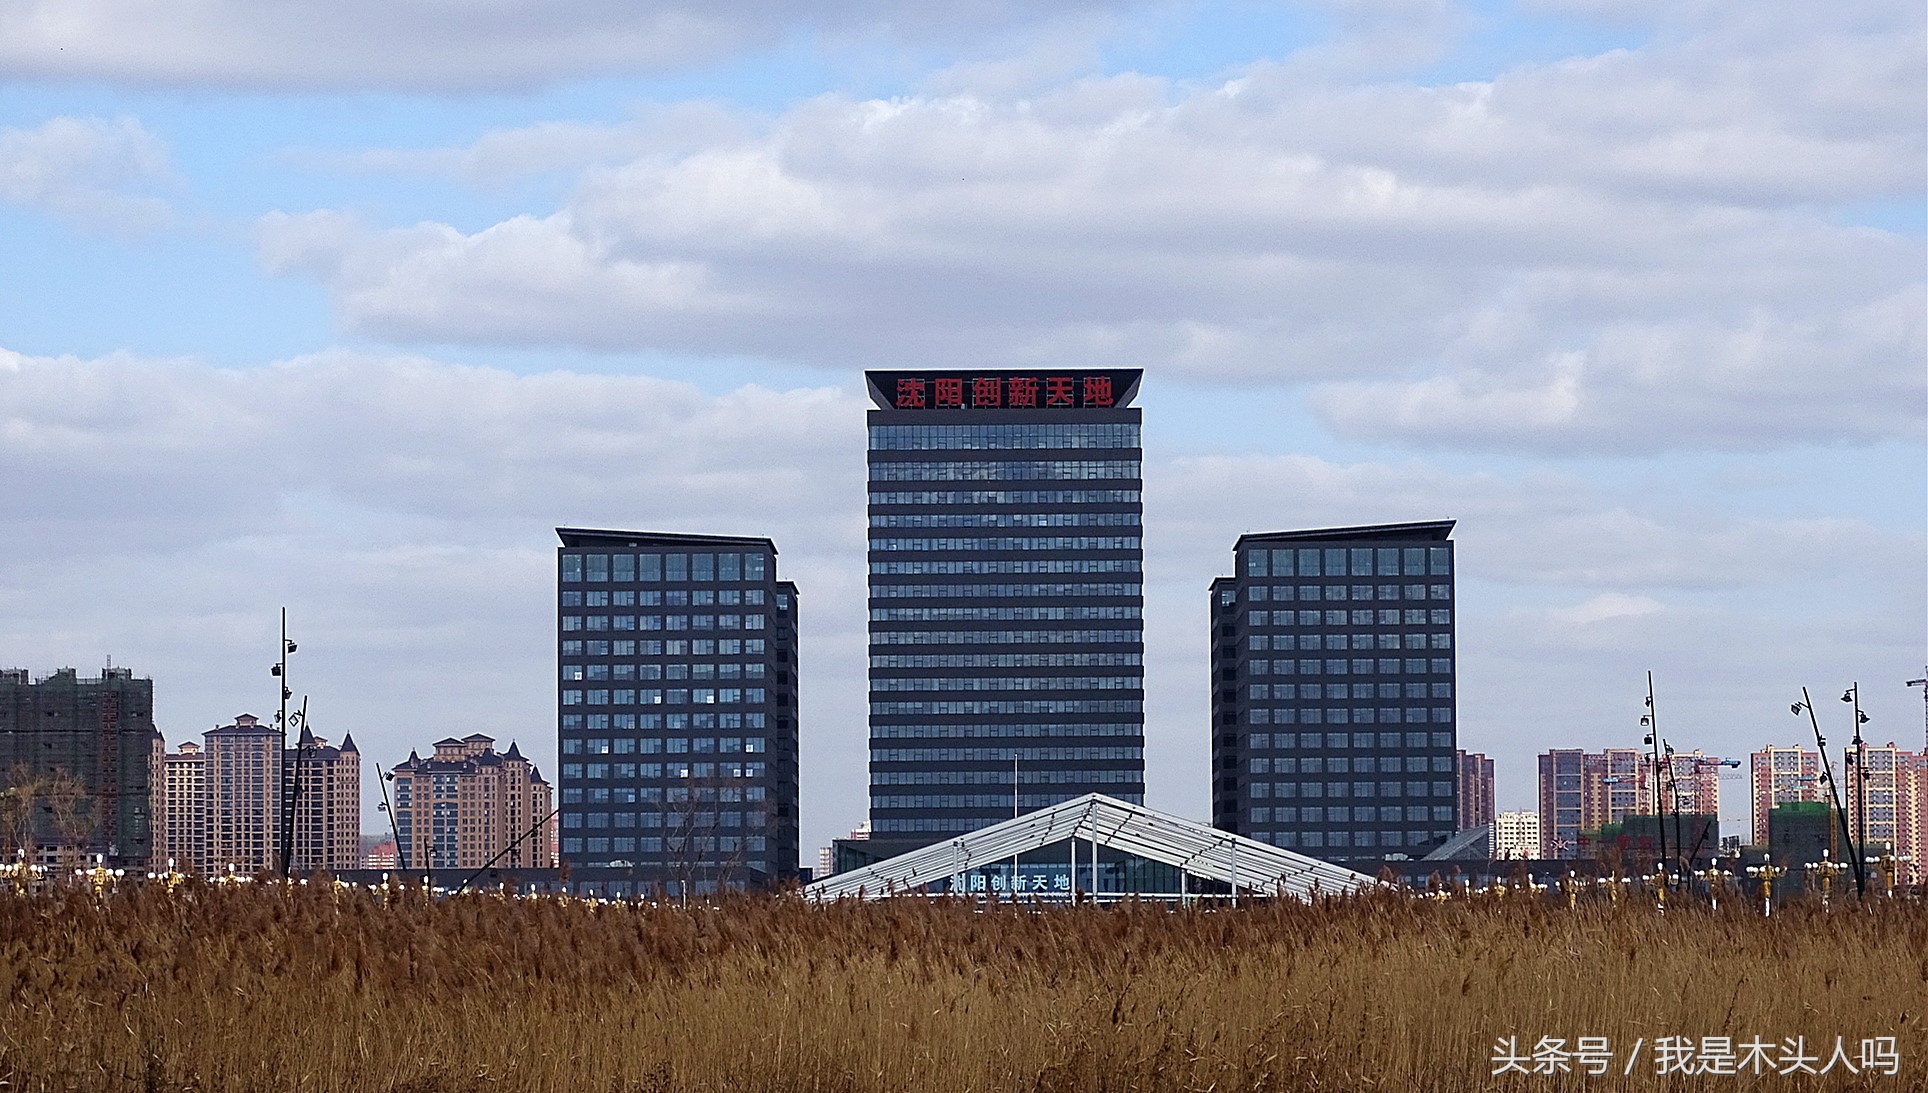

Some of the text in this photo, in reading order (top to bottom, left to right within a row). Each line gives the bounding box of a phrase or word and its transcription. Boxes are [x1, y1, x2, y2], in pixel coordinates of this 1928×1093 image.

[896, 376, 1113, 407] 沈阳创新天地
